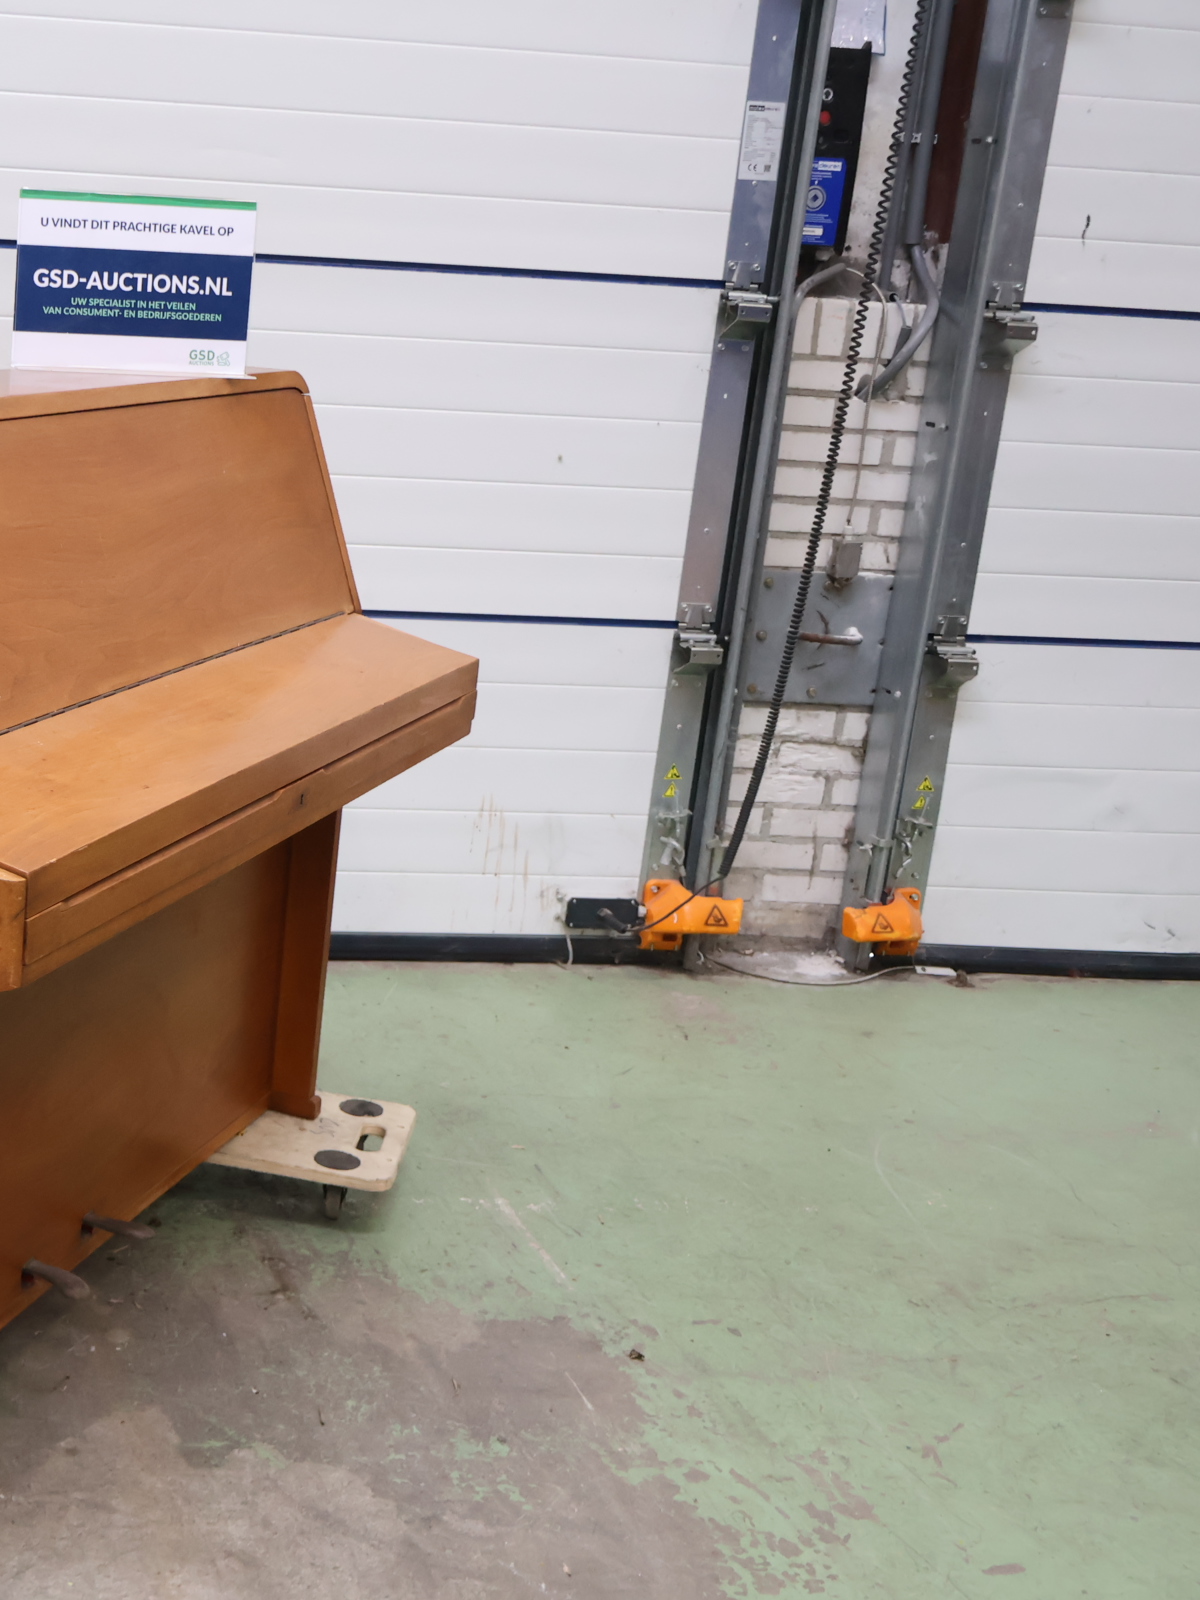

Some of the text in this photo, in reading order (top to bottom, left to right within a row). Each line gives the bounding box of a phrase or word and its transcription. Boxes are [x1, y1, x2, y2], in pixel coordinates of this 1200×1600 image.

[40, 216, 234, 237] U VINDT DIT PRACHTIGE KAVEL OP
[33, 267, 233, 297] GSD-AUCTIONS.NL
[71, 297, 196, 311] UW SPECIALIST IN HET VEILEN
[43, 306, 222, 322] VAN CONSUMENT- EN BEDRIJFSGOEDEREN
[189, 349, 215, 361] GSD
